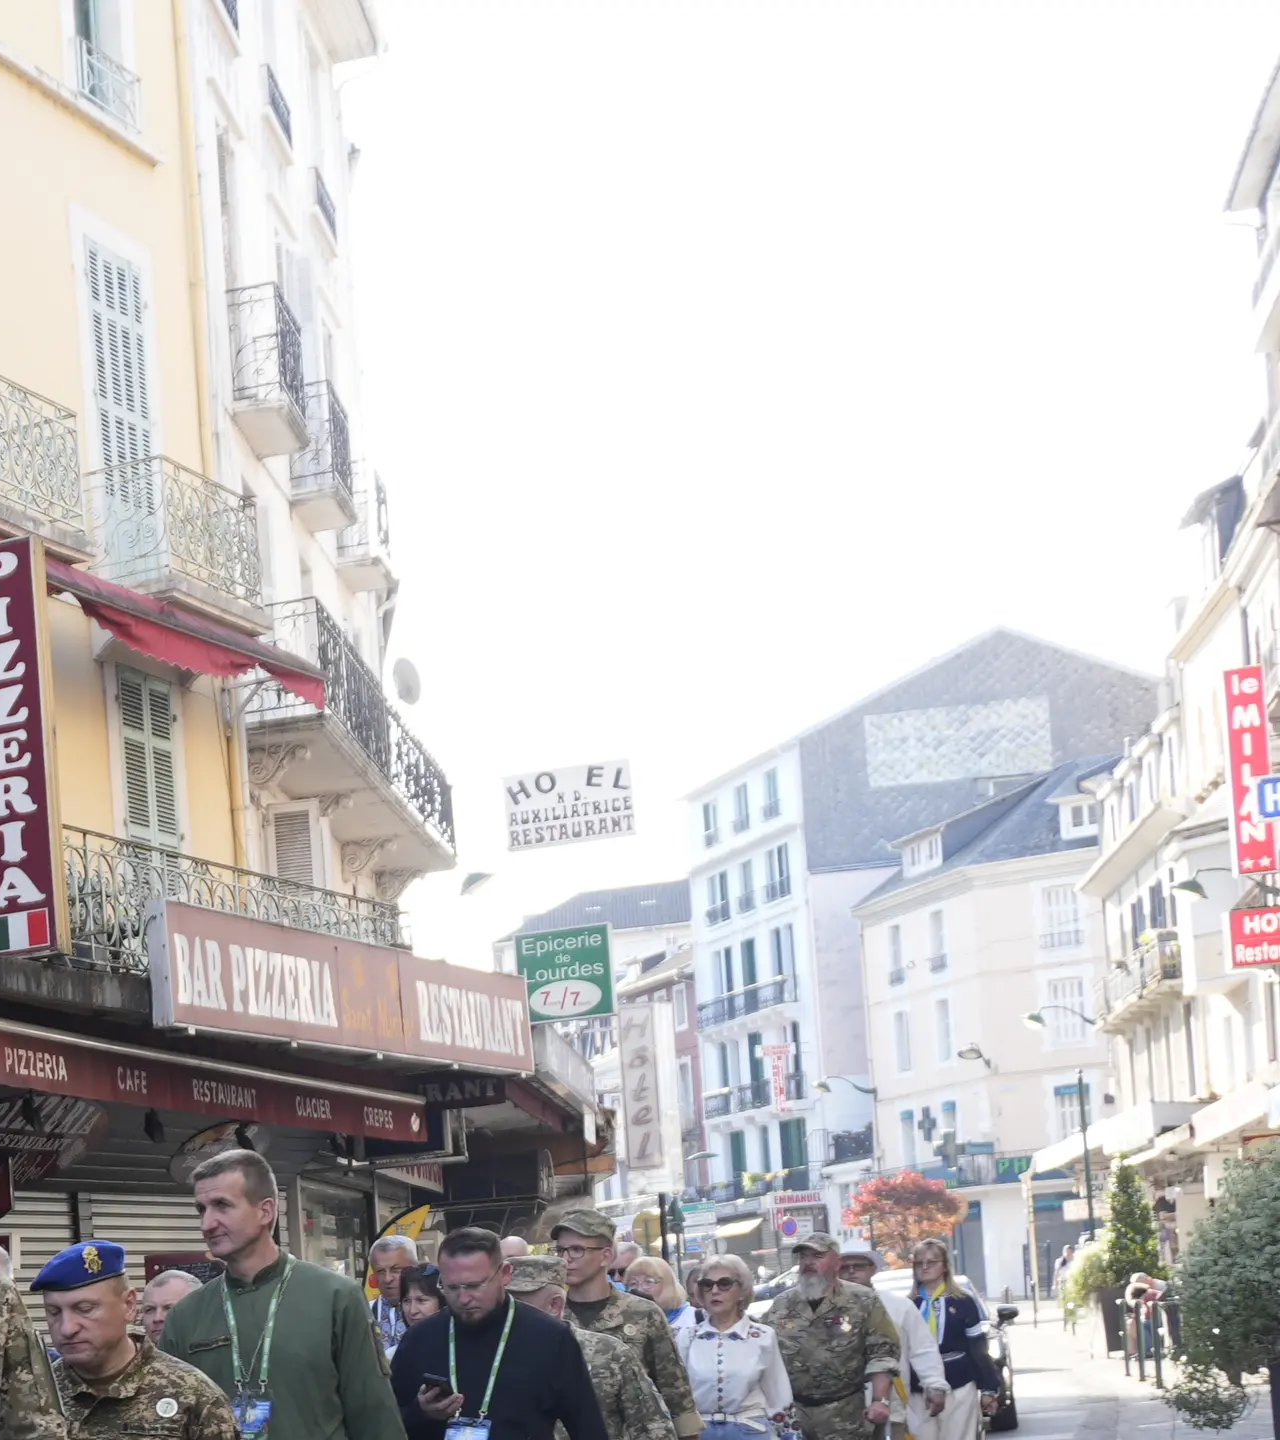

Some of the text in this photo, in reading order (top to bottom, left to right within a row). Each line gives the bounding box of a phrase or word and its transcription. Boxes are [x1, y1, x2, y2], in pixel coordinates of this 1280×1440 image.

[1231, 674, 1259, 696] le
[506, 765, 631, 806] HOEL
[509, 796, 633, 827] AUXILIATRICE
[510, 814, 635, 847] RESTAURANT
[522, 931, 602, 957] Epicerie
[555, 953, 571, 964] de
[173, 932, 338, 1028] BAR PIZZERIA
[524, 961, 604, 983] Lourdes
[415, 980, 525, 1057] RESTAURANT
[4, 1046, 394, 1130] PIZZERIA CAFE RESTAURANT GLACIER CREPES
[774, 1192, 822, 1205] EMMANUEL
